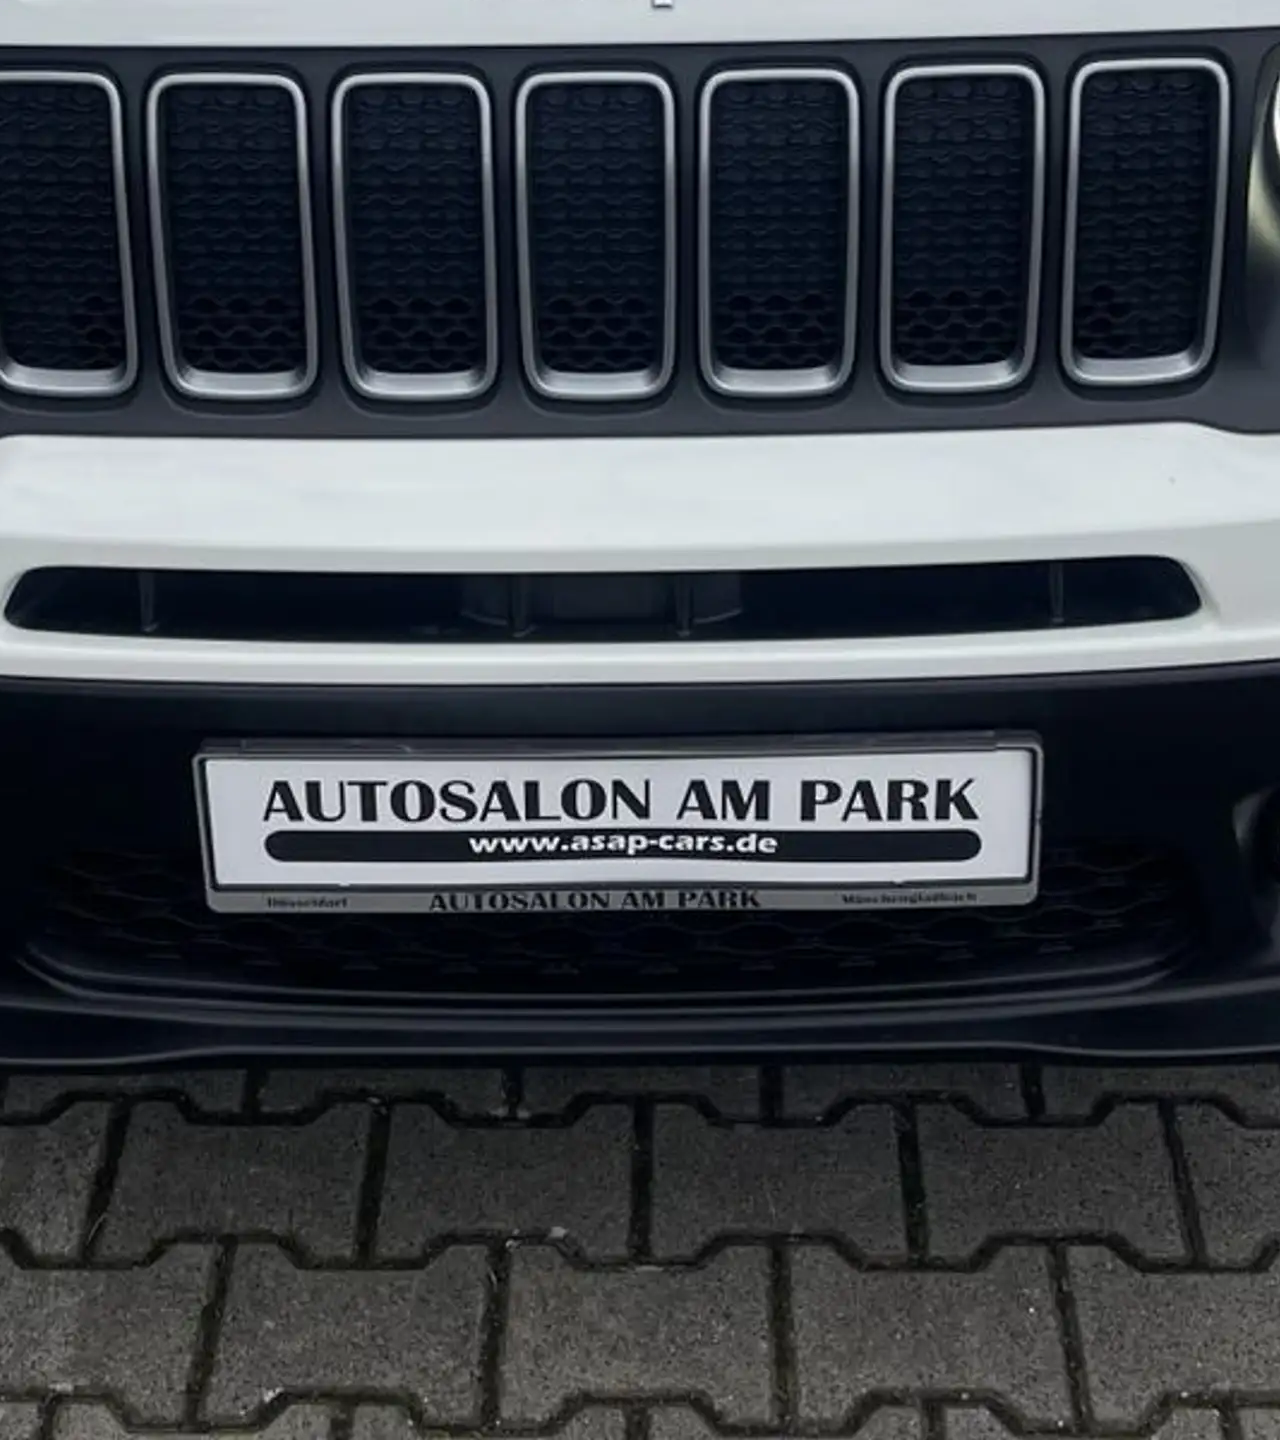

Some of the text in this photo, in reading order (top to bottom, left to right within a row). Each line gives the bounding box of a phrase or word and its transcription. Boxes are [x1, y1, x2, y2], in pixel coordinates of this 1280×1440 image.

[263, 778, 979, 822] AUTOSALON AM PARK
[469, 832, 778, 855] www.asap-cars.de
[429, 889, 762, 911] AUTOSALON AM PARK
